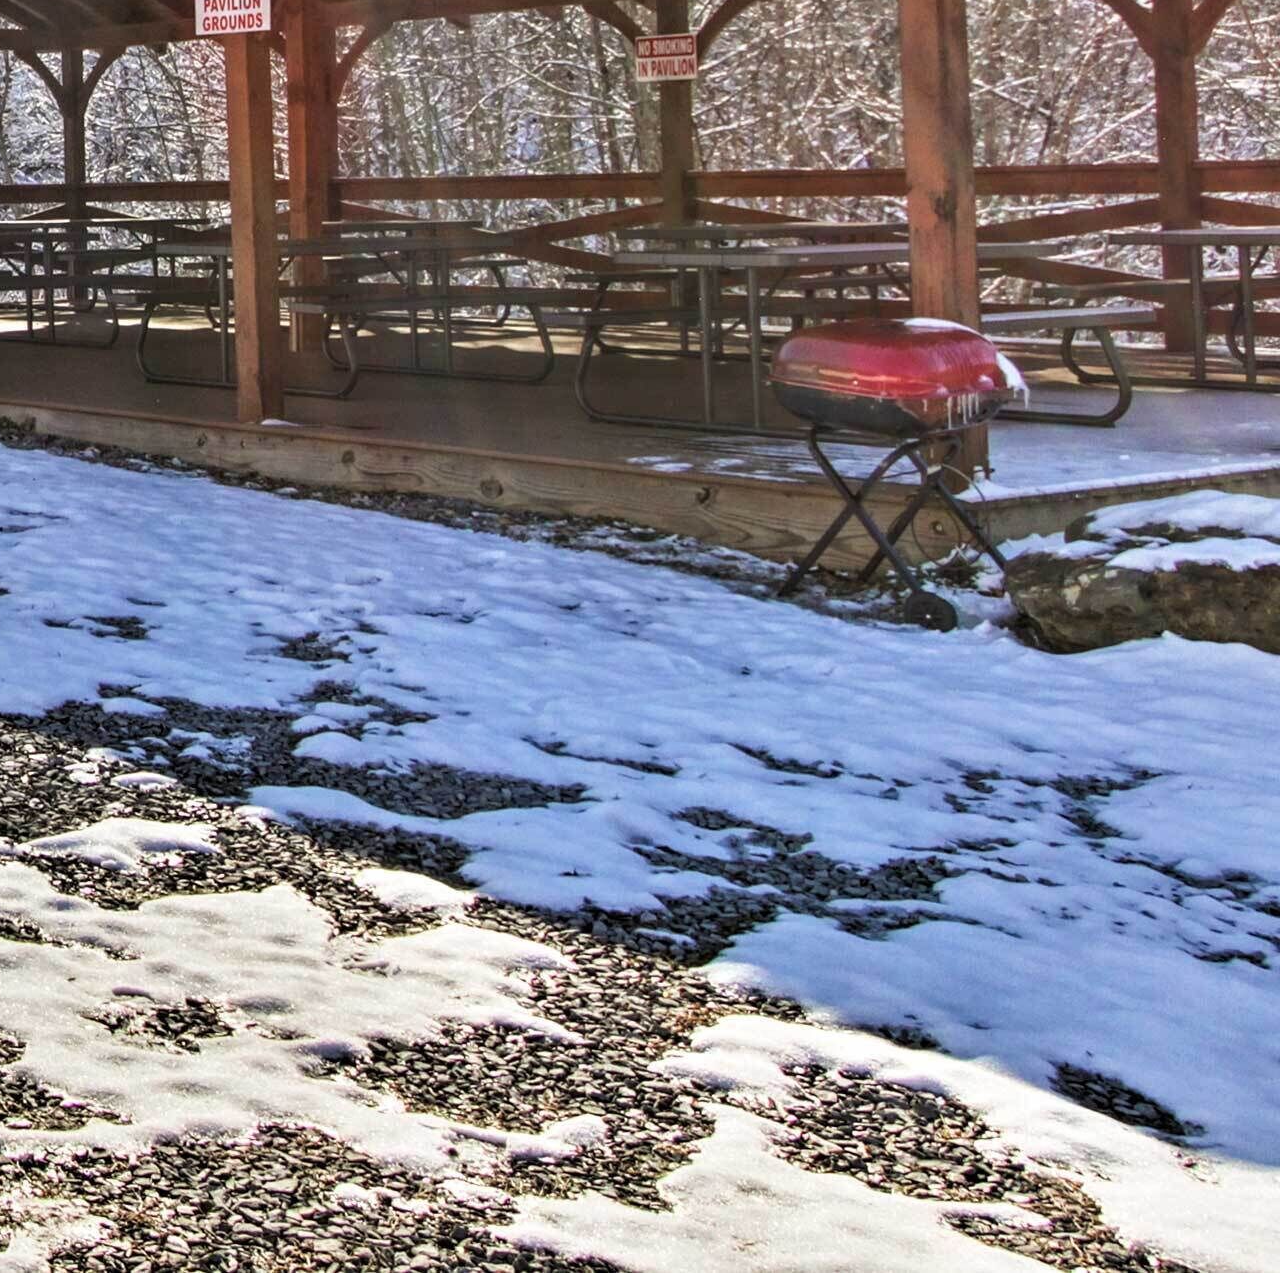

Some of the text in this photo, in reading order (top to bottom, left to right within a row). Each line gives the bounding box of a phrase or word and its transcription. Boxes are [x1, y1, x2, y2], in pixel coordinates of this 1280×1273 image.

[203, 13, 263, 31] GROUNDS
[639, 38, 692, 56] NO SMOKING
[638, 59, 695, 77] IN PAVILION
